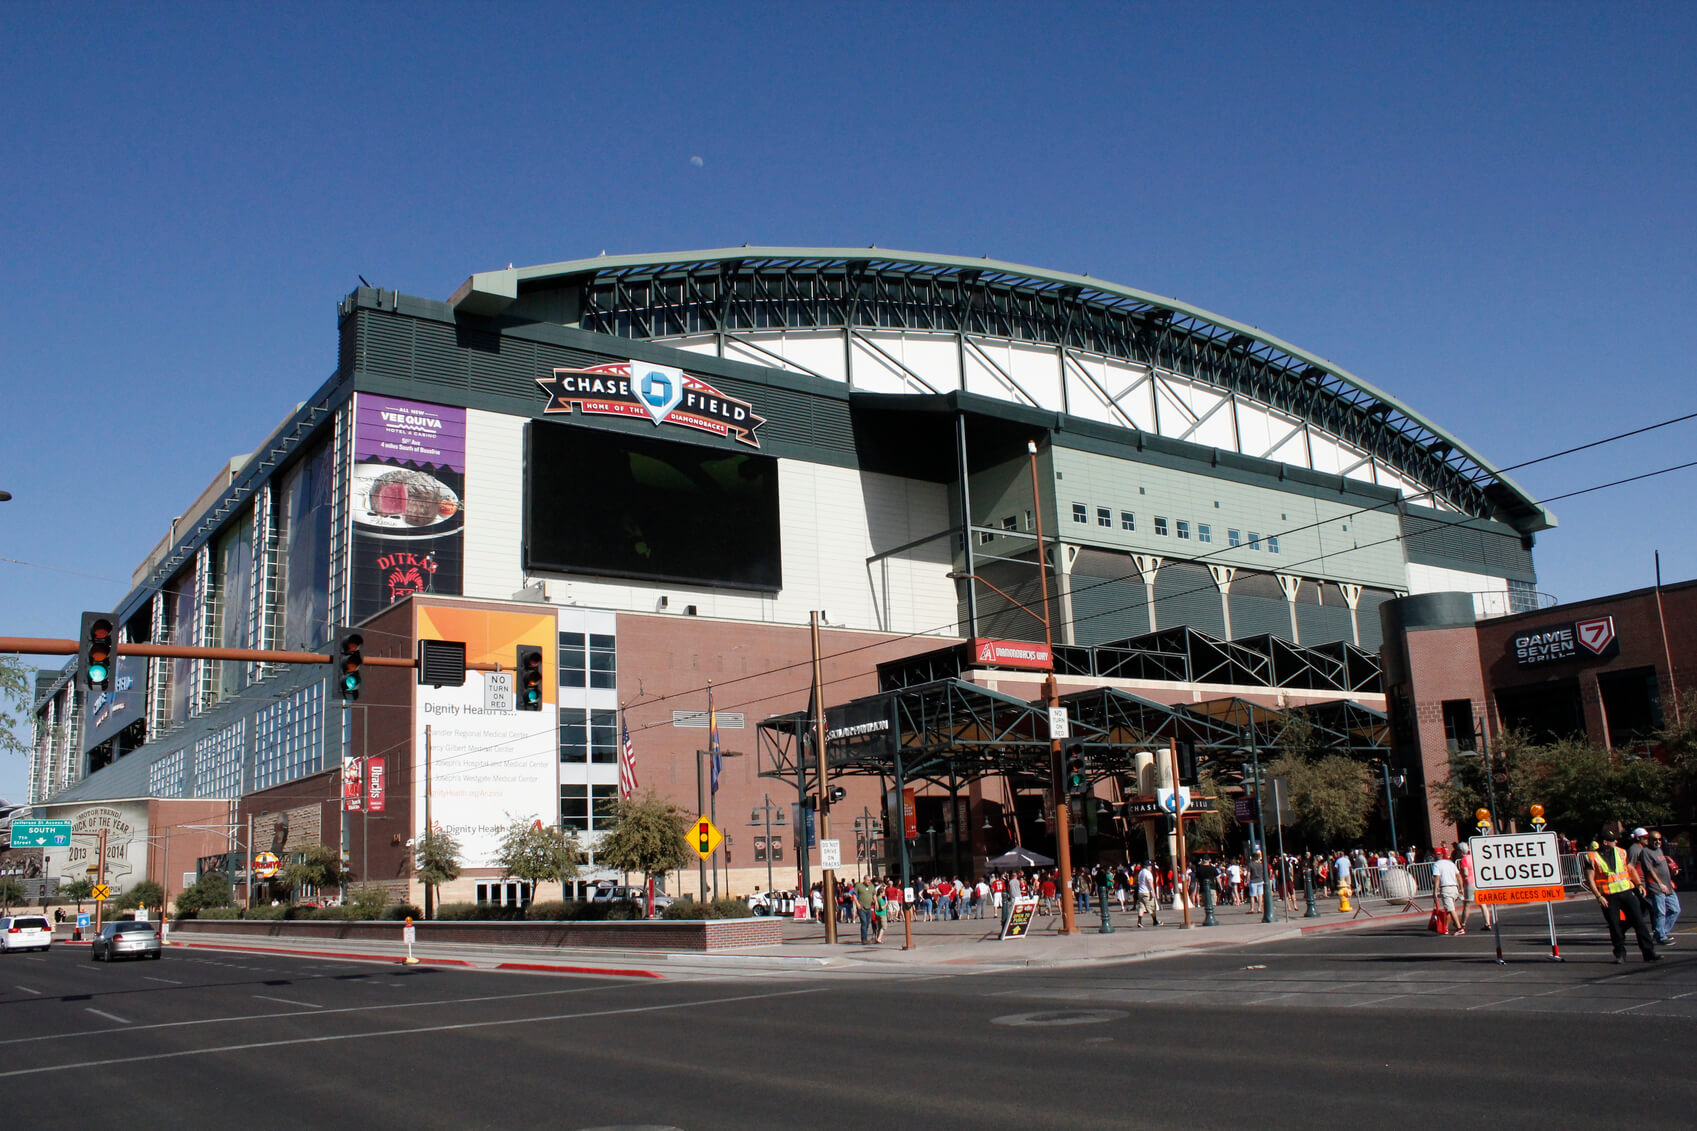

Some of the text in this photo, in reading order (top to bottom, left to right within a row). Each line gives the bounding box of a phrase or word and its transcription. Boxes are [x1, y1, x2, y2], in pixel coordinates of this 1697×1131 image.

[562, 377, 746, 420] CHASE FIELD
[381, 412, 442, 428] VEE QUIVA
[630, 406, 644, 414] THE
[670, 414, 725, 432] DIAMONDBACKS
[1516, 629, 1572, 648] GAME
[1585, 624, 1605, 643] 7
[1517, 640, 1574, 658] SEVEN
[1528, 652, 1566, 663] GRILL
[492, 675, 506, 684] NO
[424, 702, 460, 716] Dignity
[454, 730, 481, 739] Regional
[78, 809, 119, 820] MOTOR TREND
[89, 817, 96, 827] OF
[99, 817, 111, 827] THE
[114, 819, 129, 834] YEAR
[446, 825, 477, 835] Dignity
[69, 845, 124, 861] 2013 2014
[1482, 841, 1546, 860] STREET
[1481, 863, 1554, 881] CLOSED
[1478, 889, 1561, 902] GARAGE ACCESS ONLY
